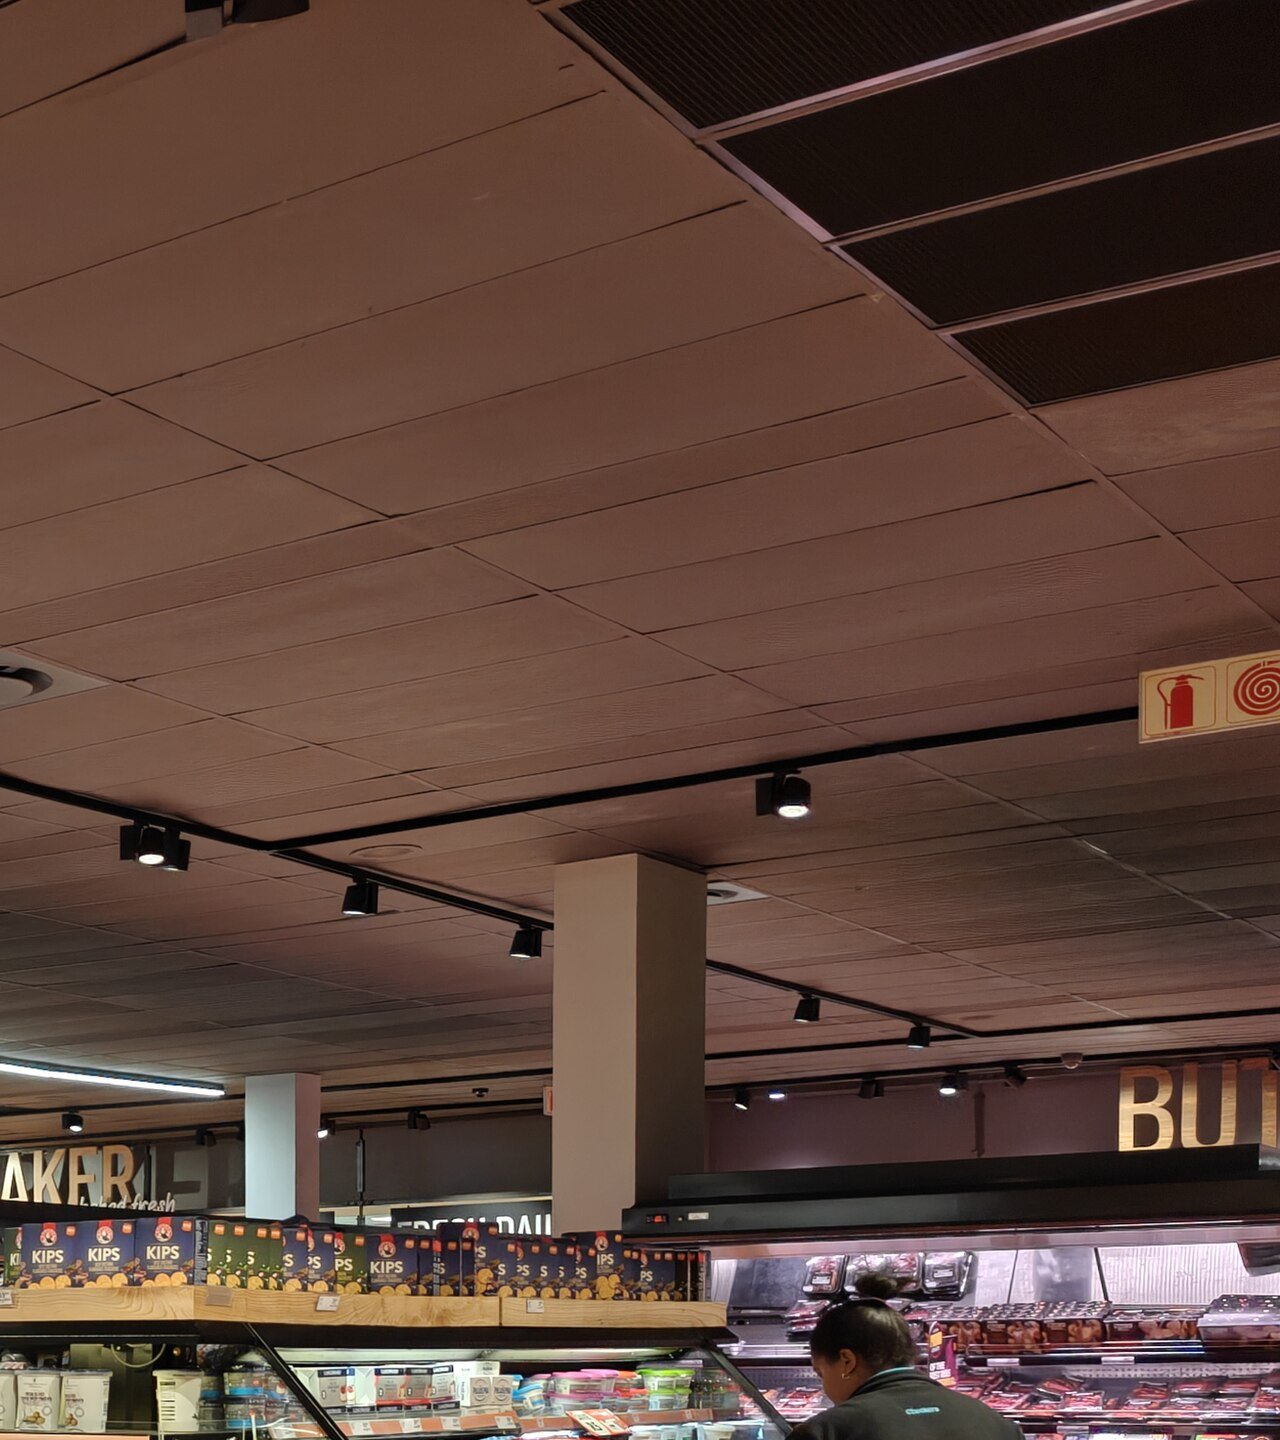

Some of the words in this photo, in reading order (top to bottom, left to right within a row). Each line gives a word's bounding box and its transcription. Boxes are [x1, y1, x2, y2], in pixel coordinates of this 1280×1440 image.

[32, 1250, 64, 1263] KIPS
[88, 1248, 120, 1262] KIPS
[146, 1245, 180, 1260] KIPS
[370, 1261, 403, 1274] KIPS
